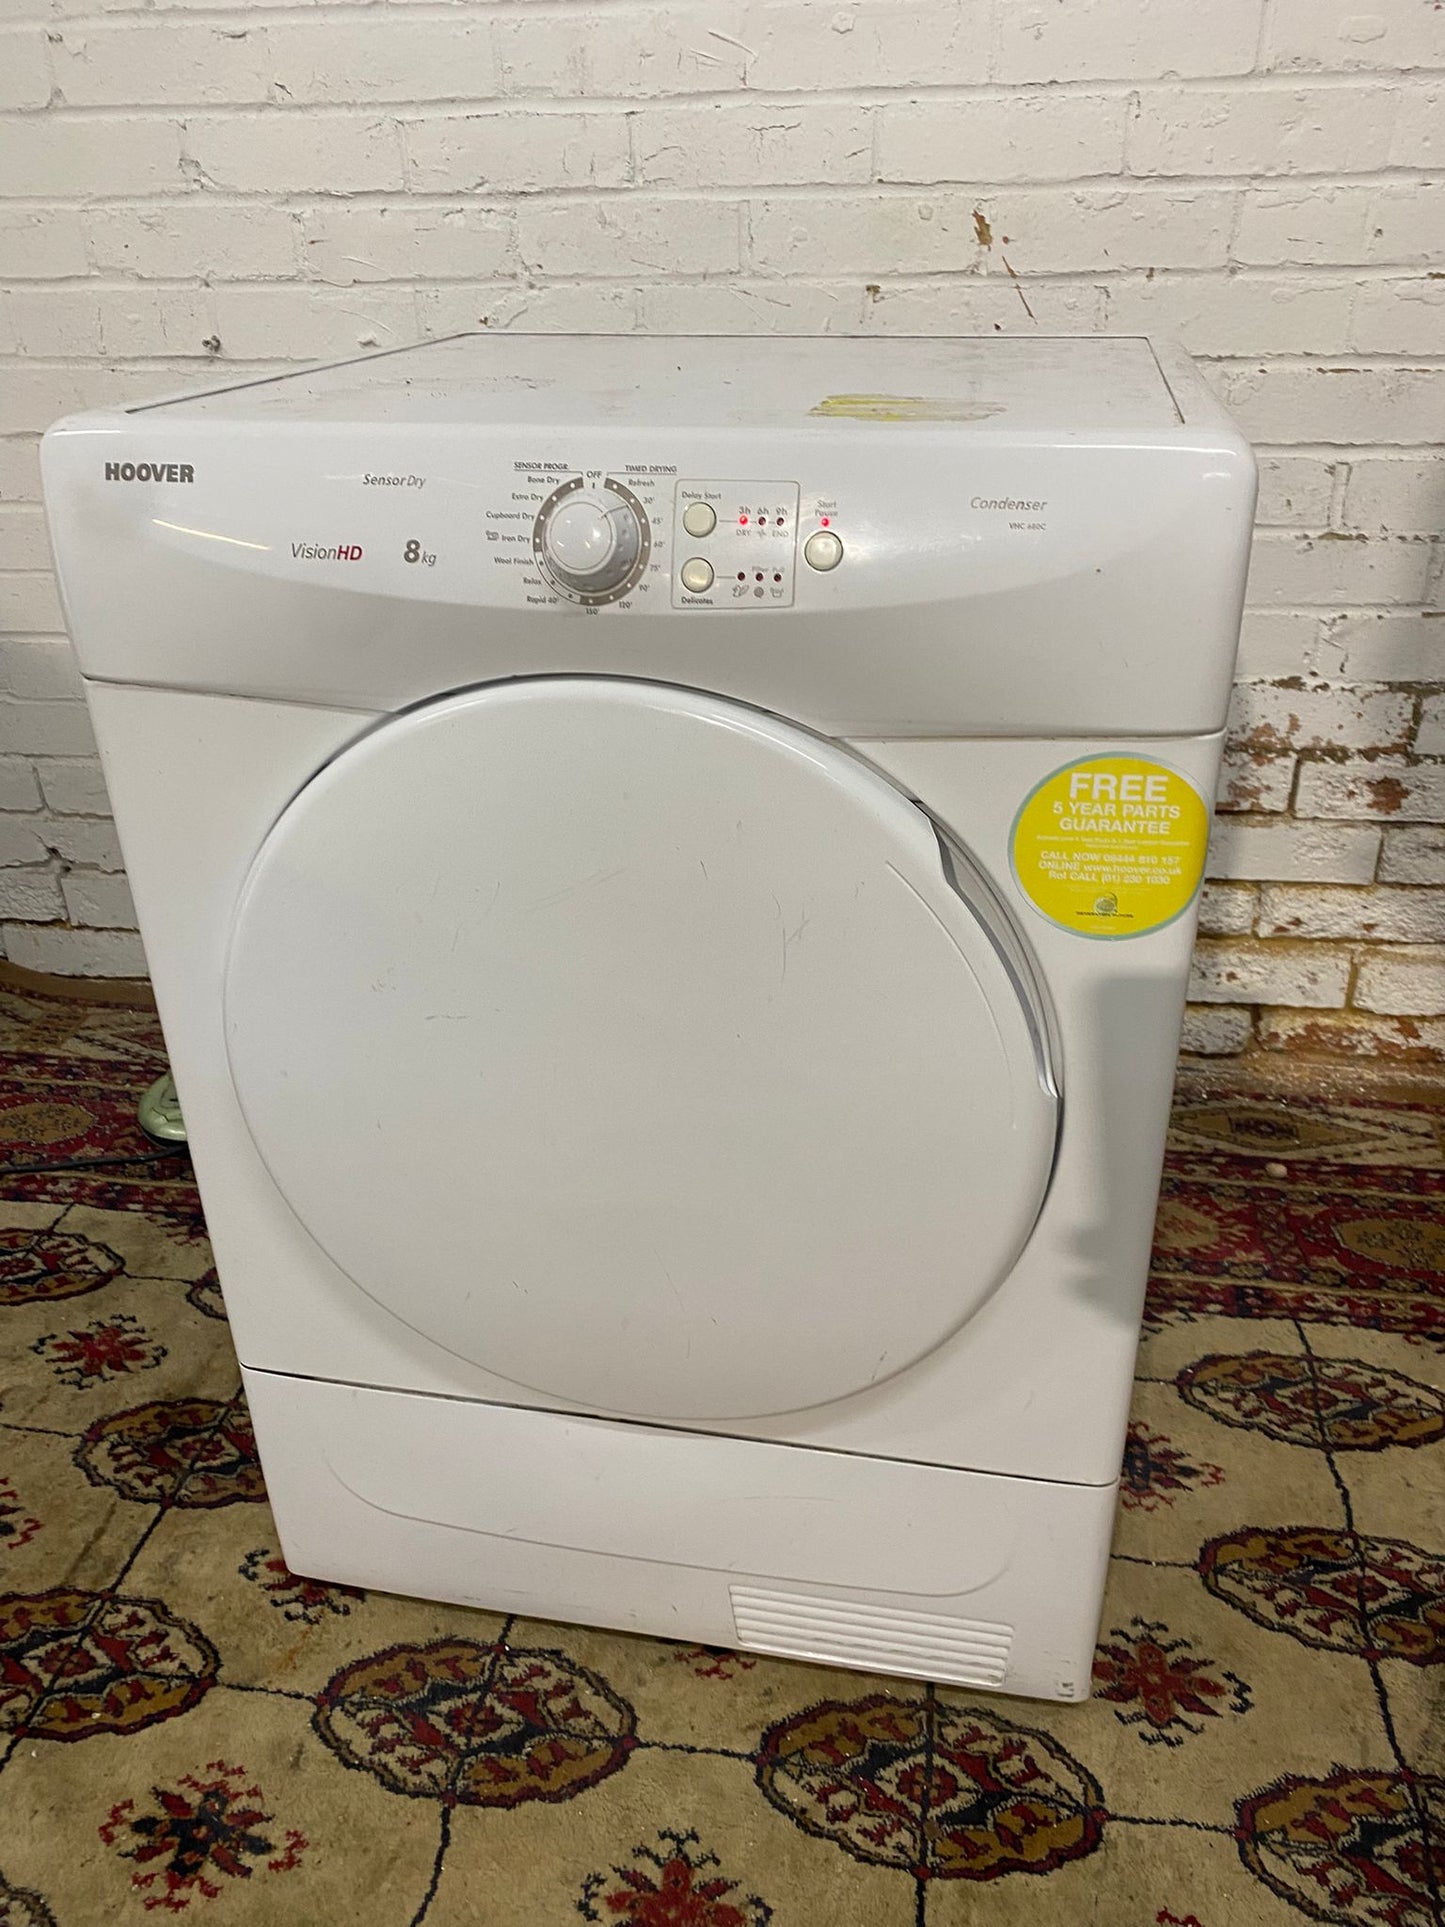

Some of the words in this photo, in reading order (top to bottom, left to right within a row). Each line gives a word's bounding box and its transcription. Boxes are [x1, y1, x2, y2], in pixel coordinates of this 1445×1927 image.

[514, 461, 542, 469] SENSOR
[649, 465, 677, 473] DRYING
[105, 462, 194, 483] HOOVER
[586, 471, 602, 479] OFF
[528, 475, 545, 483] Bone
[547, 476, 559, 485] Dry
[628, 479, 655, 487] Refresh
[531, 493, 544, 502] Dry
[681, 491, 702, 500] Delay
[704, 491, 722, 500] Start
[817, 499, 837, 508] Start
[970, 496, 1048, 511] Condenser
[739, 506, 751, 515] 3h
[757, 507, 769, 515] 6h
[776, 507, 788, 515] 9h
[815, 509, 838, 517] Pause
[486, 511, 520, 520] Cupboard
[522, 513, 534, 521] Dry
[736, 529, 752, 537] DRY
[518, 535, 530, 544] Dry
[290, 542, 363, 561] VisionHD
[494, 556, 512, 564] Wool
[513, 557, 534, 565] Finish
[526, 595, 546, 605] Rapid
[681, 596, 713, 605] Delicates
[1069, 772, 1169, 802] FREE
[1053, 802, 1063, 815] 5
[1069, 801, 1117, 817] YEAR
[1122, 803, 1180, 819] PARTS
[1059, 817, 1171, 835] GUARANTEE
[1041, 850, 1068, 860] CALL
[1072, 852, 1100, 862] NOW
[1038, 860, 1080, 871] ONLINE
[1084, 863, 1182, 876] www.hoover.co.uk
[1070, 872, 1098, 882] CALL
